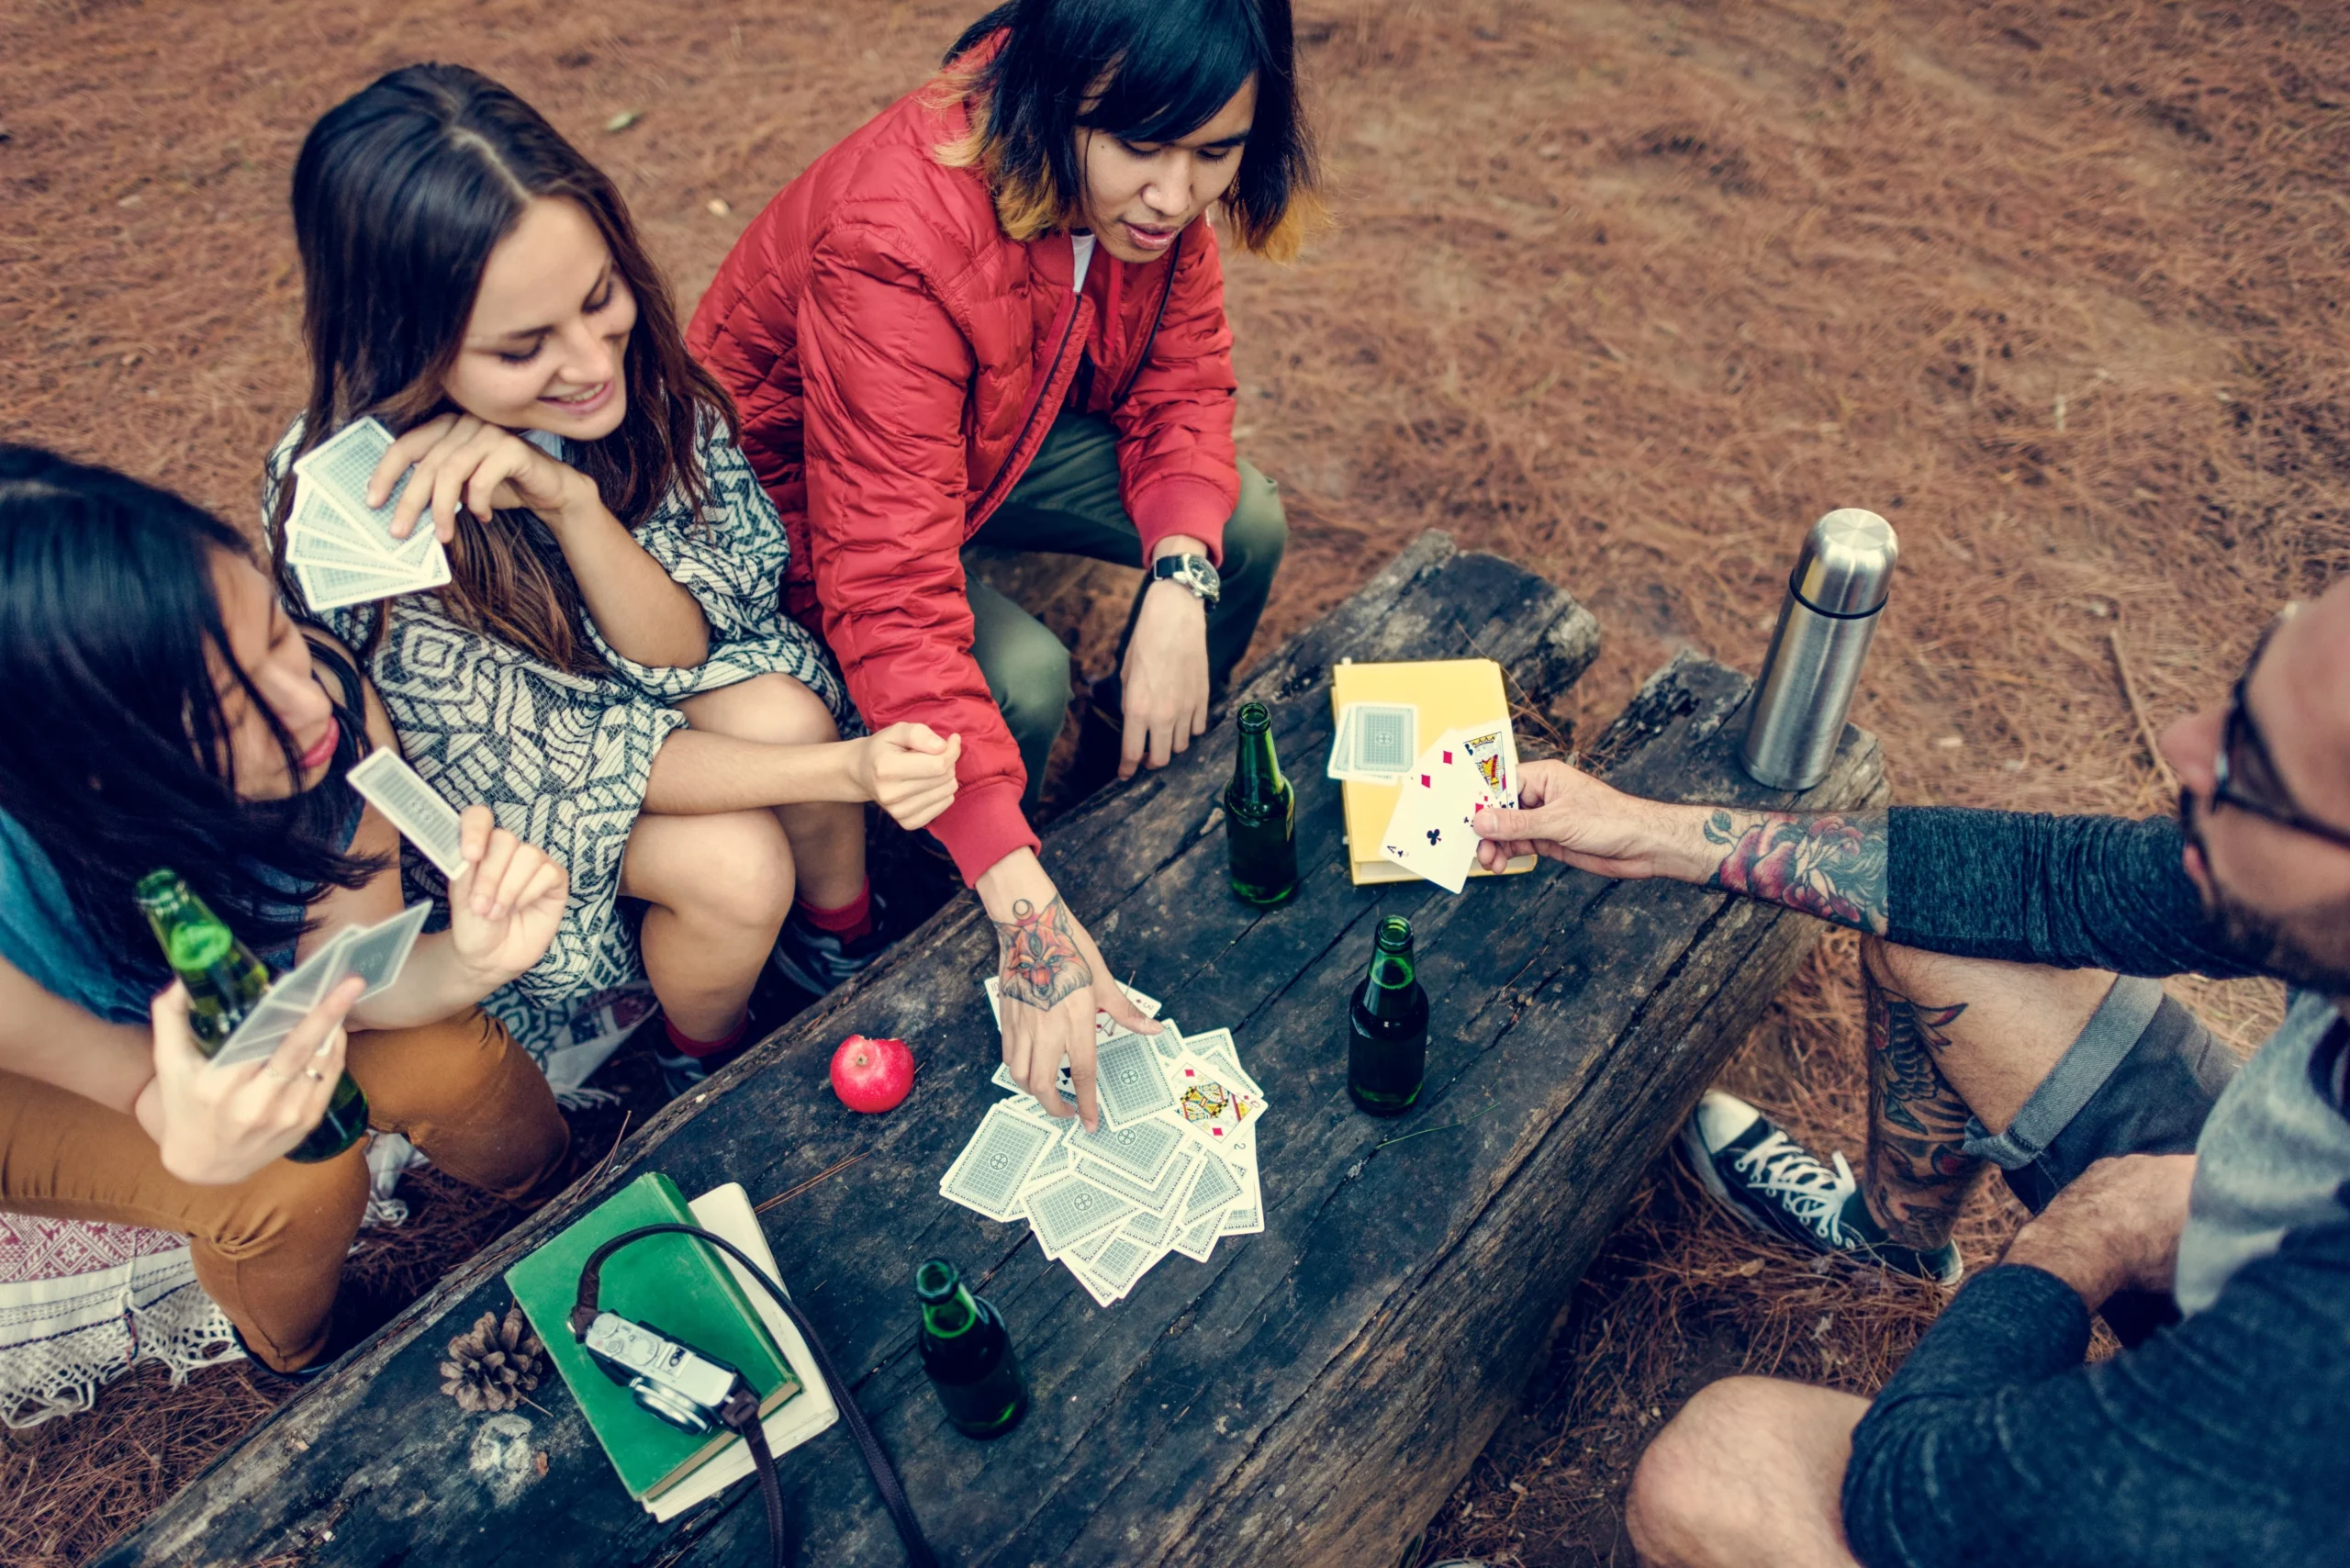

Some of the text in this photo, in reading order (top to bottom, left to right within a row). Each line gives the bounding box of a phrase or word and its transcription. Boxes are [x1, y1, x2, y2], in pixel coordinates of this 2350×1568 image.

[1386, 845, 1396, 854] A
[1143, 1002, 1154, 1011] 3
[1250, 1100, 1260, 1109] Q
[1234, 1142, 1247, 1150] 2
